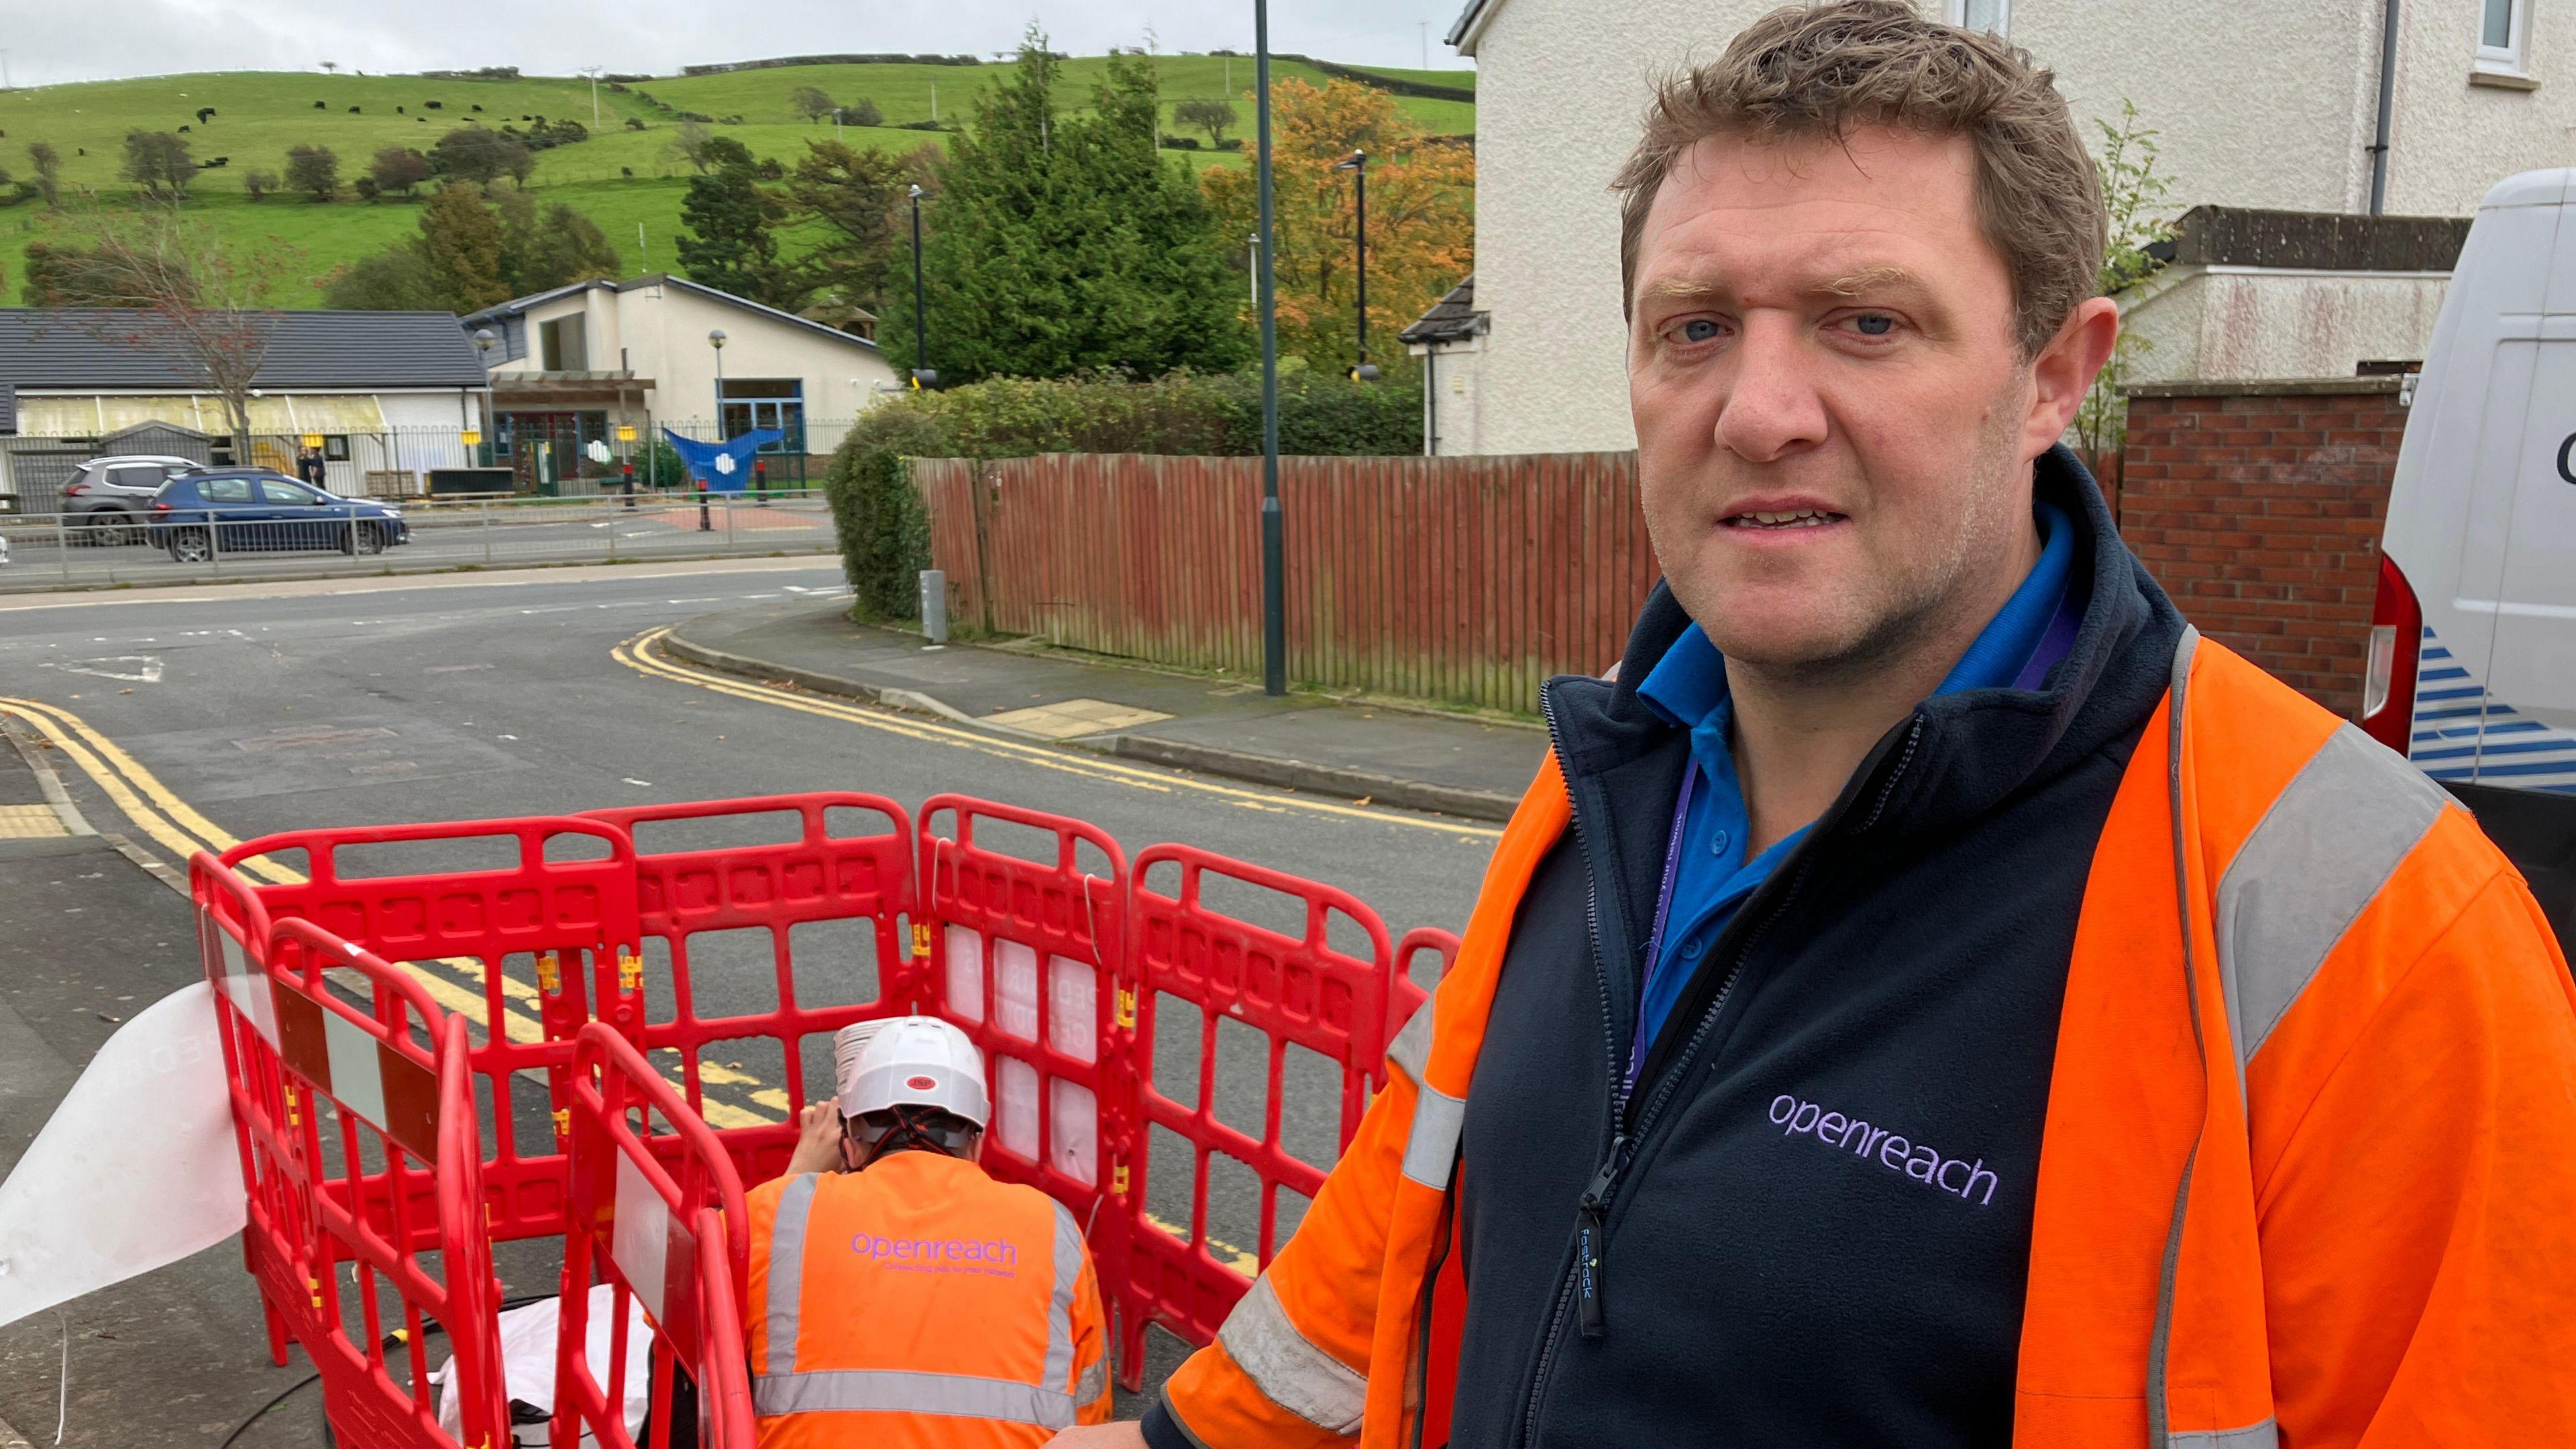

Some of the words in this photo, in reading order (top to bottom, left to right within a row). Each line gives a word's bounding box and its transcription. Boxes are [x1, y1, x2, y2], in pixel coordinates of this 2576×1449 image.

[913, 1078, 932, 1086] JSP
[1769, 1095, 1998, 1205] openreach
[851, 1233, 1017, 1265] openreach
